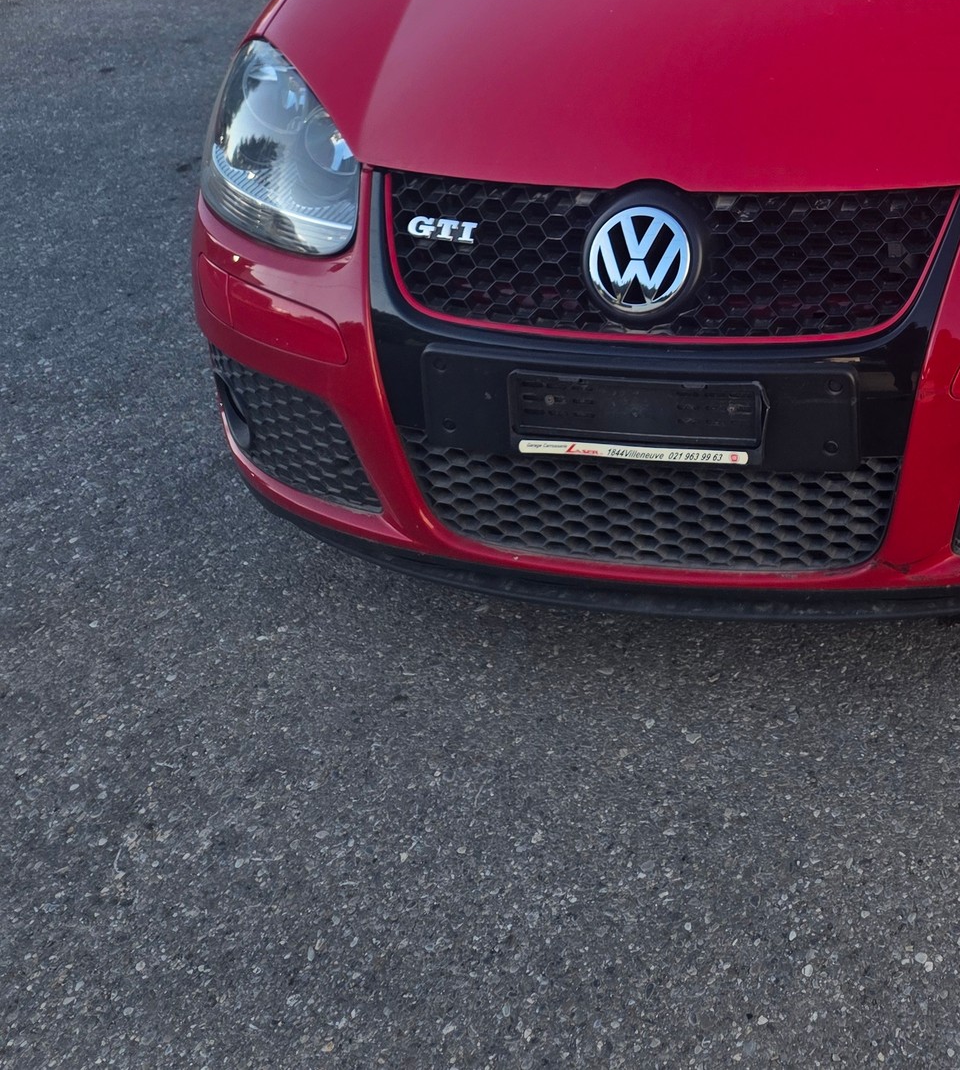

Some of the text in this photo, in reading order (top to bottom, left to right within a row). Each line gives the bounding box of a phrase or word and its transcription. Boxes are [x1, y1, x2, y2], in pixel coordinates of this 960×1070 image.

[407, 216, 478, 244] GTI
[590, 206, 691, 313] VW
[668, 452, 683, 460] 021
[684, 452, 700, 461] 963
[700, 453, 711, 461] 99
[712, 454, 723, 462] 63
